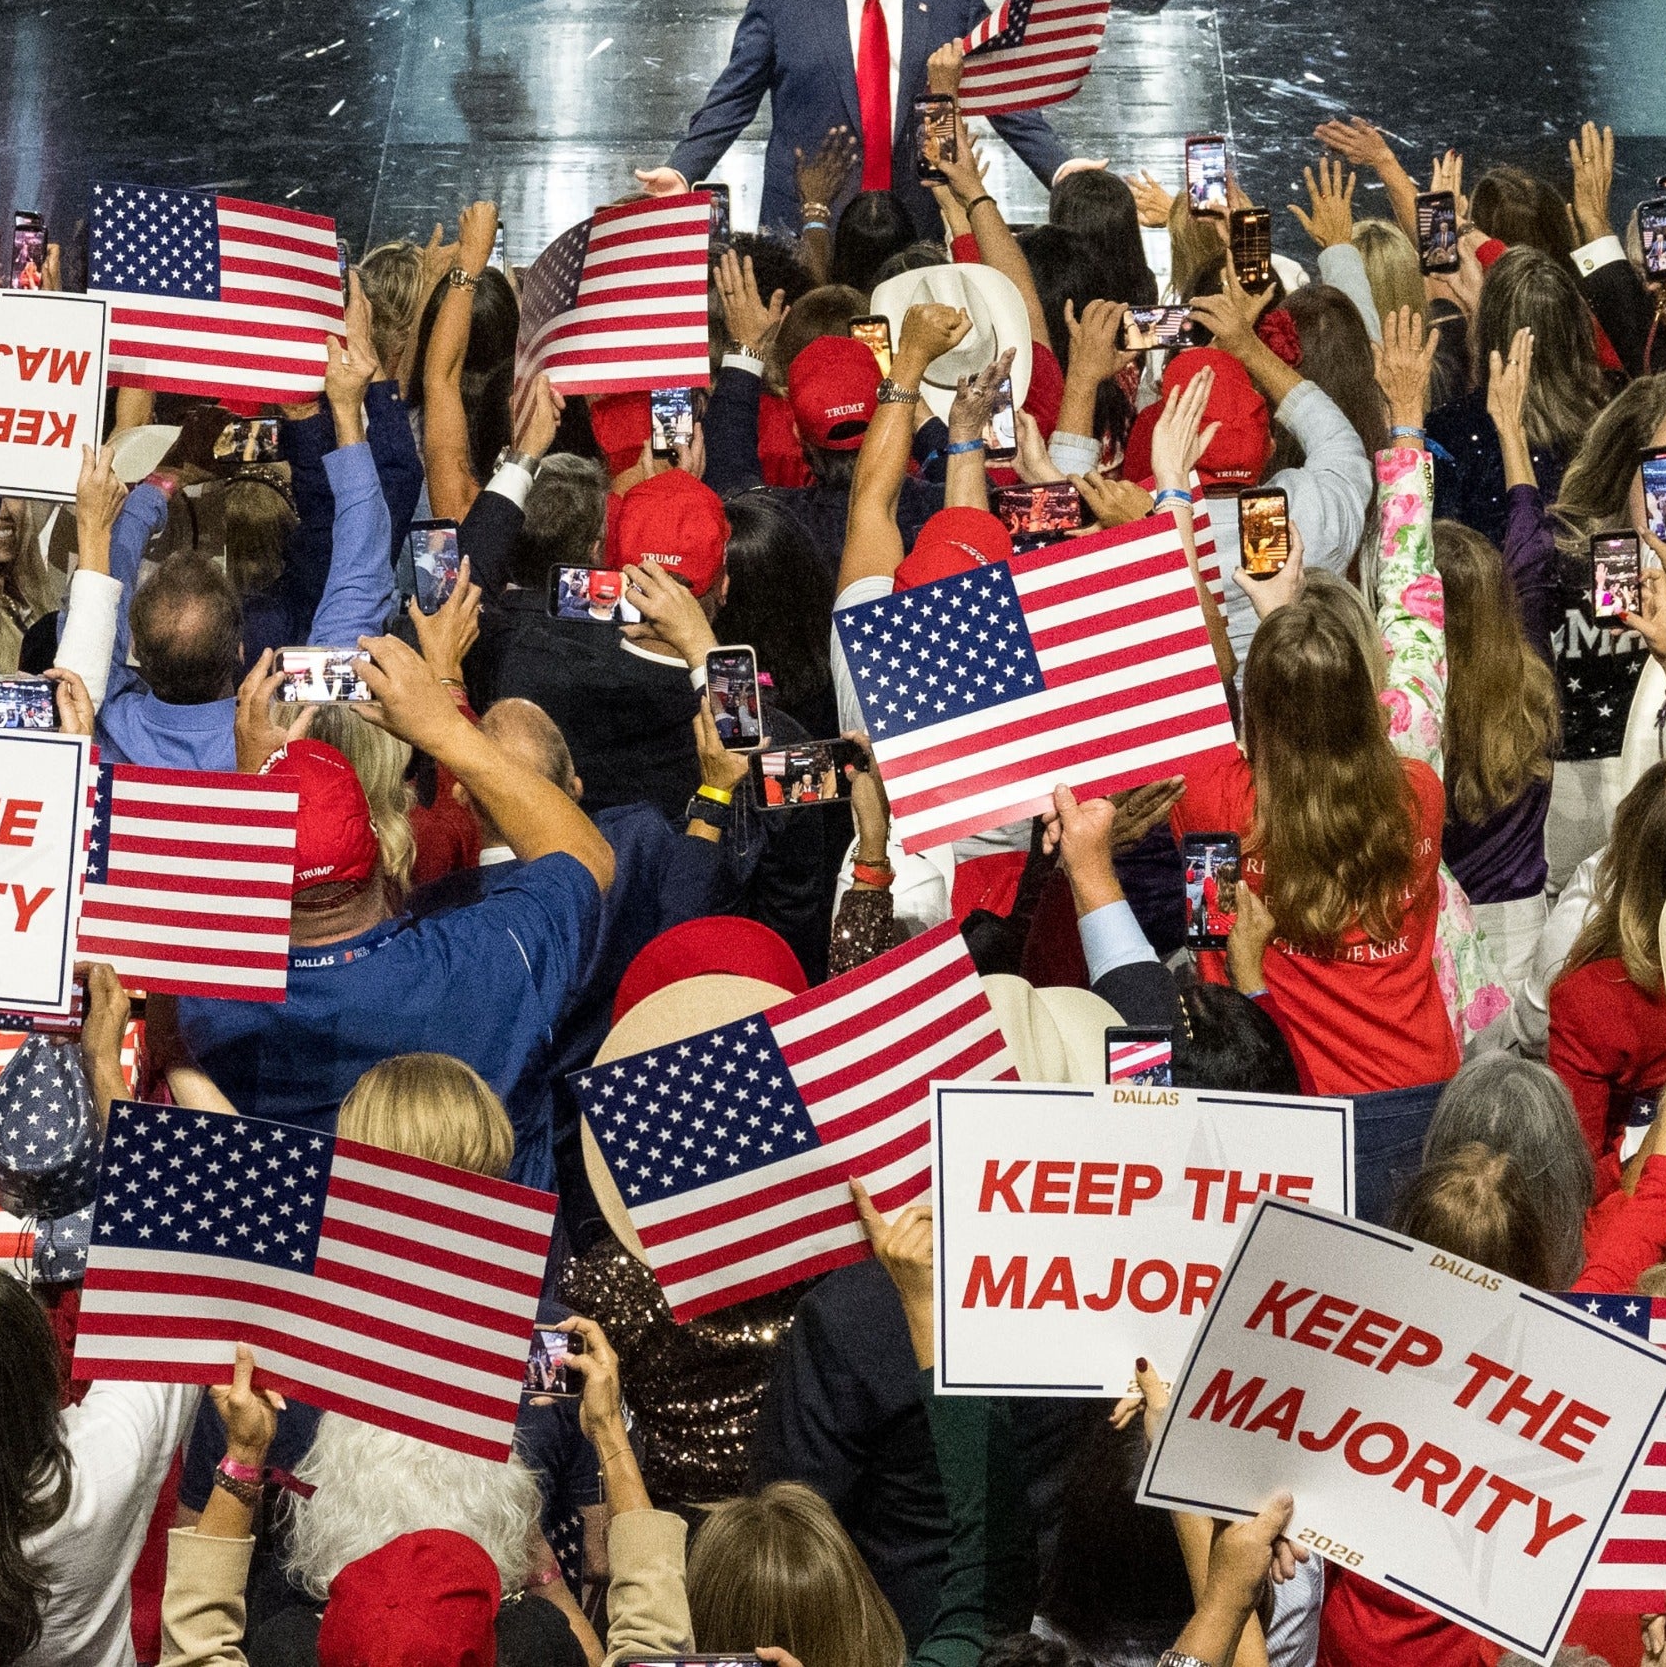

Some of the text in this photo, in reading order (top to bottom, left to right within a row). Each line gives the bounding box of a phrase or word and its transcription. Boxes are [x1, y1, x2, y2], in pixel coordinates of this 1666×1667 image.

[824, 402, 866, 419] TRUMP
[1215, 470, 1251, 479] TRUMP
[640, 552, 683, 567] TRUMP
[296, 865, 335, 882] TRUMP
[1368, 937, 1410, 961] KIRK
[295, 956, 334, 968] DALLAS
[1112, 1089, 1180, 1107] DALLAS
[979, 1160, 1313, 1223] KEEP THE
[962, 1256, 1221, 1315] MAJOR
[1429, 1253, 1504, 1294] DALLAS
[1246, 1282, 1609, 1462] KEEP THE
[1191, 1370, 1585, 1554] MAJORITY
[1296, 1527, 1365, 1568] 2026
